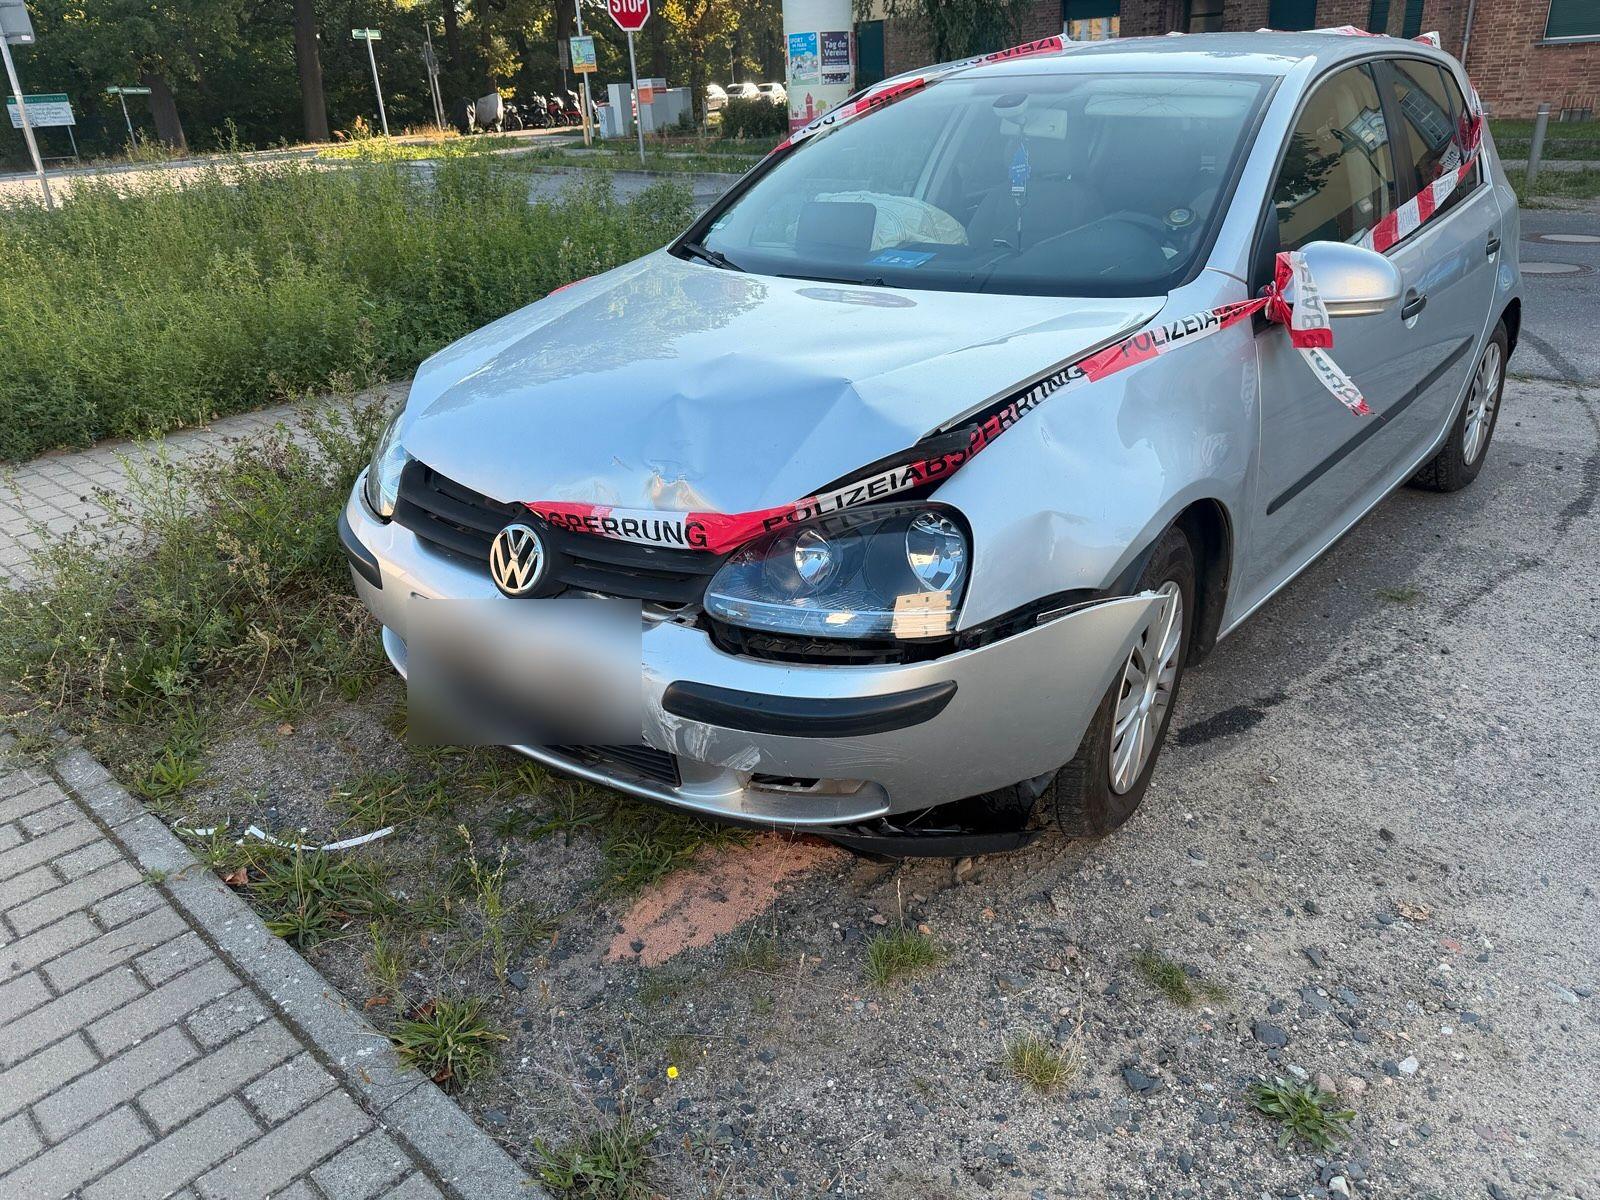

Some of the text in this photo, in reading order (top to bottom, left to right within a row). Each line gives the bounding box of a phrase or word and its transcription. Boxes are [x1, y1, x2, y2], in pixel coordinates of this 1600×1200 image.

[612, 0, 645, 13] STOP
[824, 40, 837, 50] Tag
[824, 48, 848, 57] Vereine
[490, 524, 543, 593] VW
